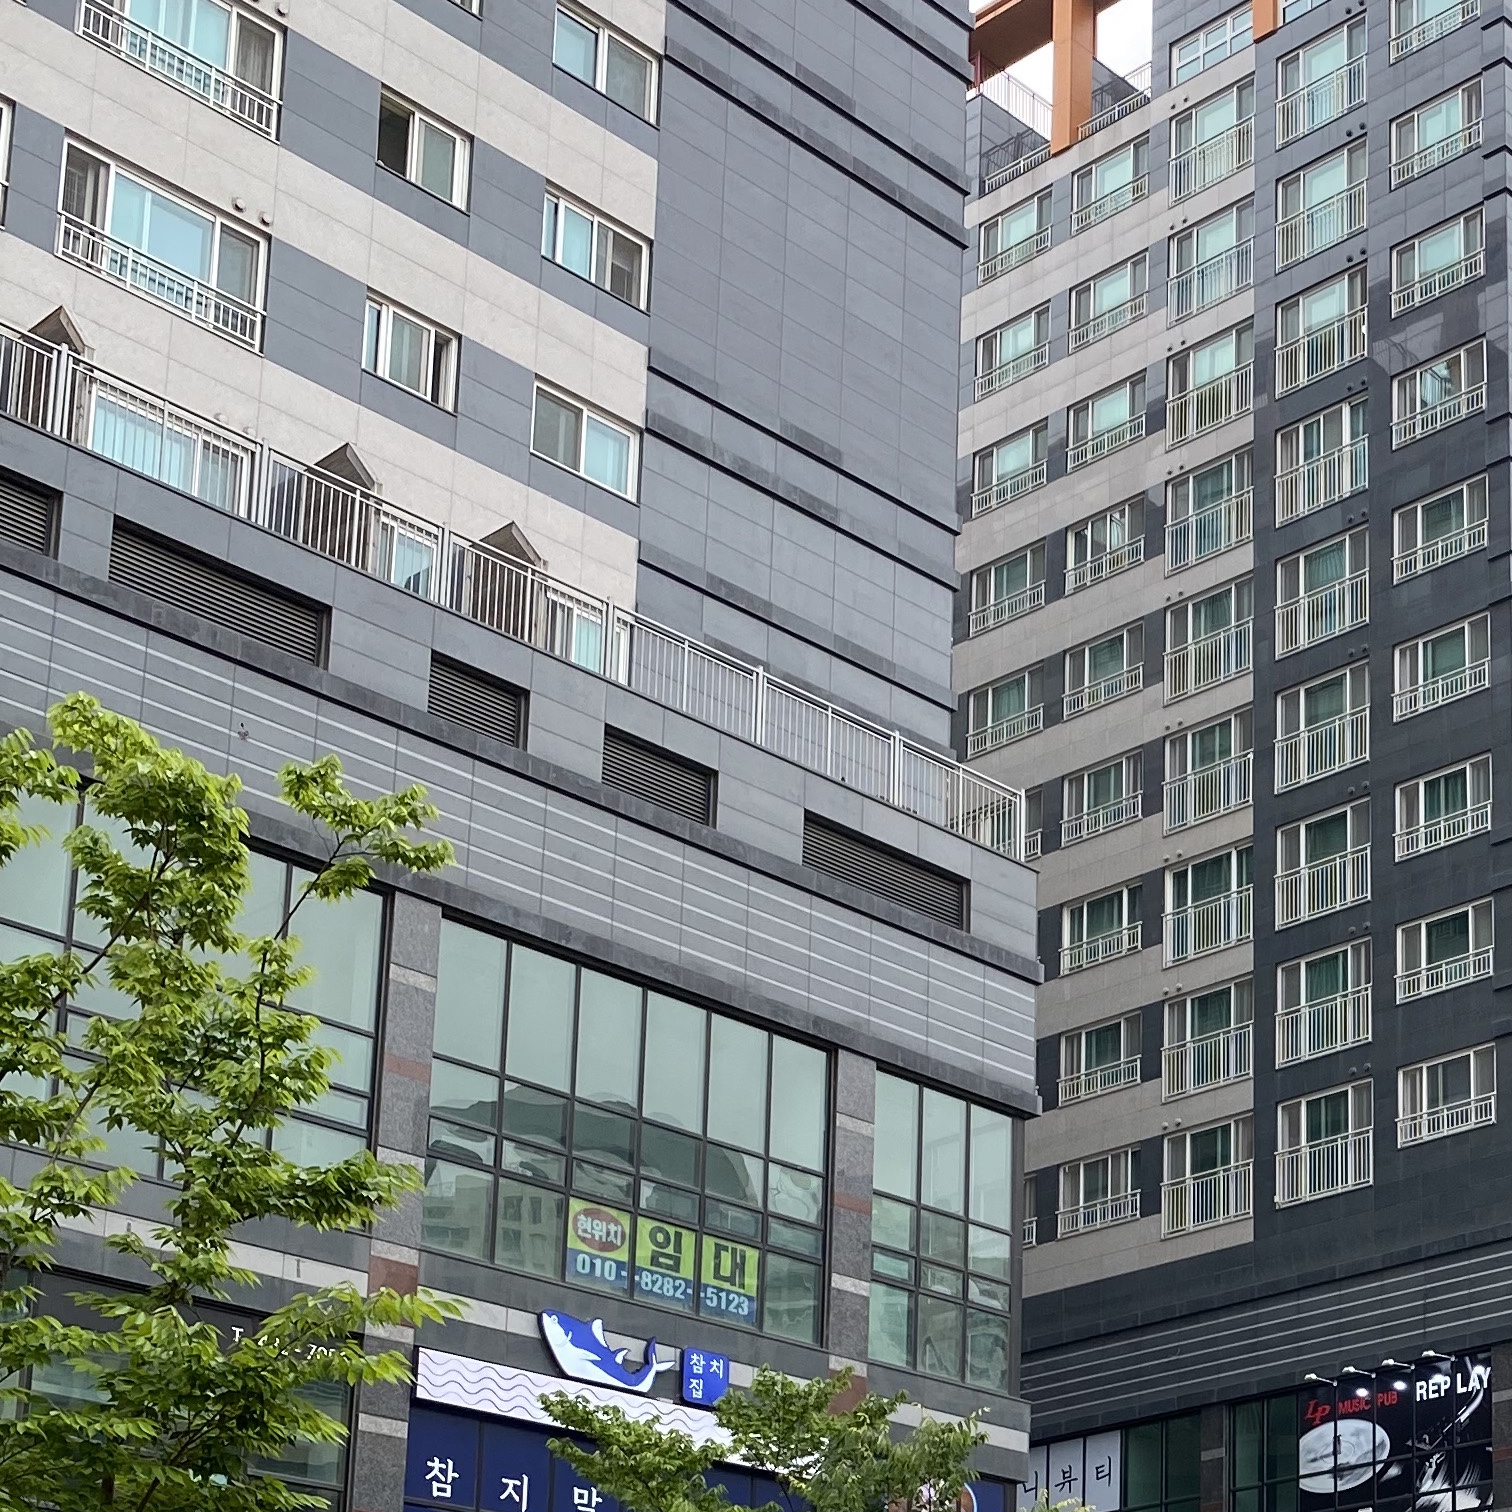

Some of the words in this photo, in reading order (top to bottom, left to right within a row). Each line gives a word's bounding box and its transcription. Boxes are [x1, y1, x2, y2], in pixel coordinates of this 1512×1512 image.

[577, 1213, 622, 1247] 현위치
[649, 1226, 746, 1290] 임대
[690, 1352, 724, 1379] 참치
[689, 1378, 704, 1399] 집
[1338, 1396, 1372, 1415] MUSIC
[1377, 1390, 1398, 1408] PUB
